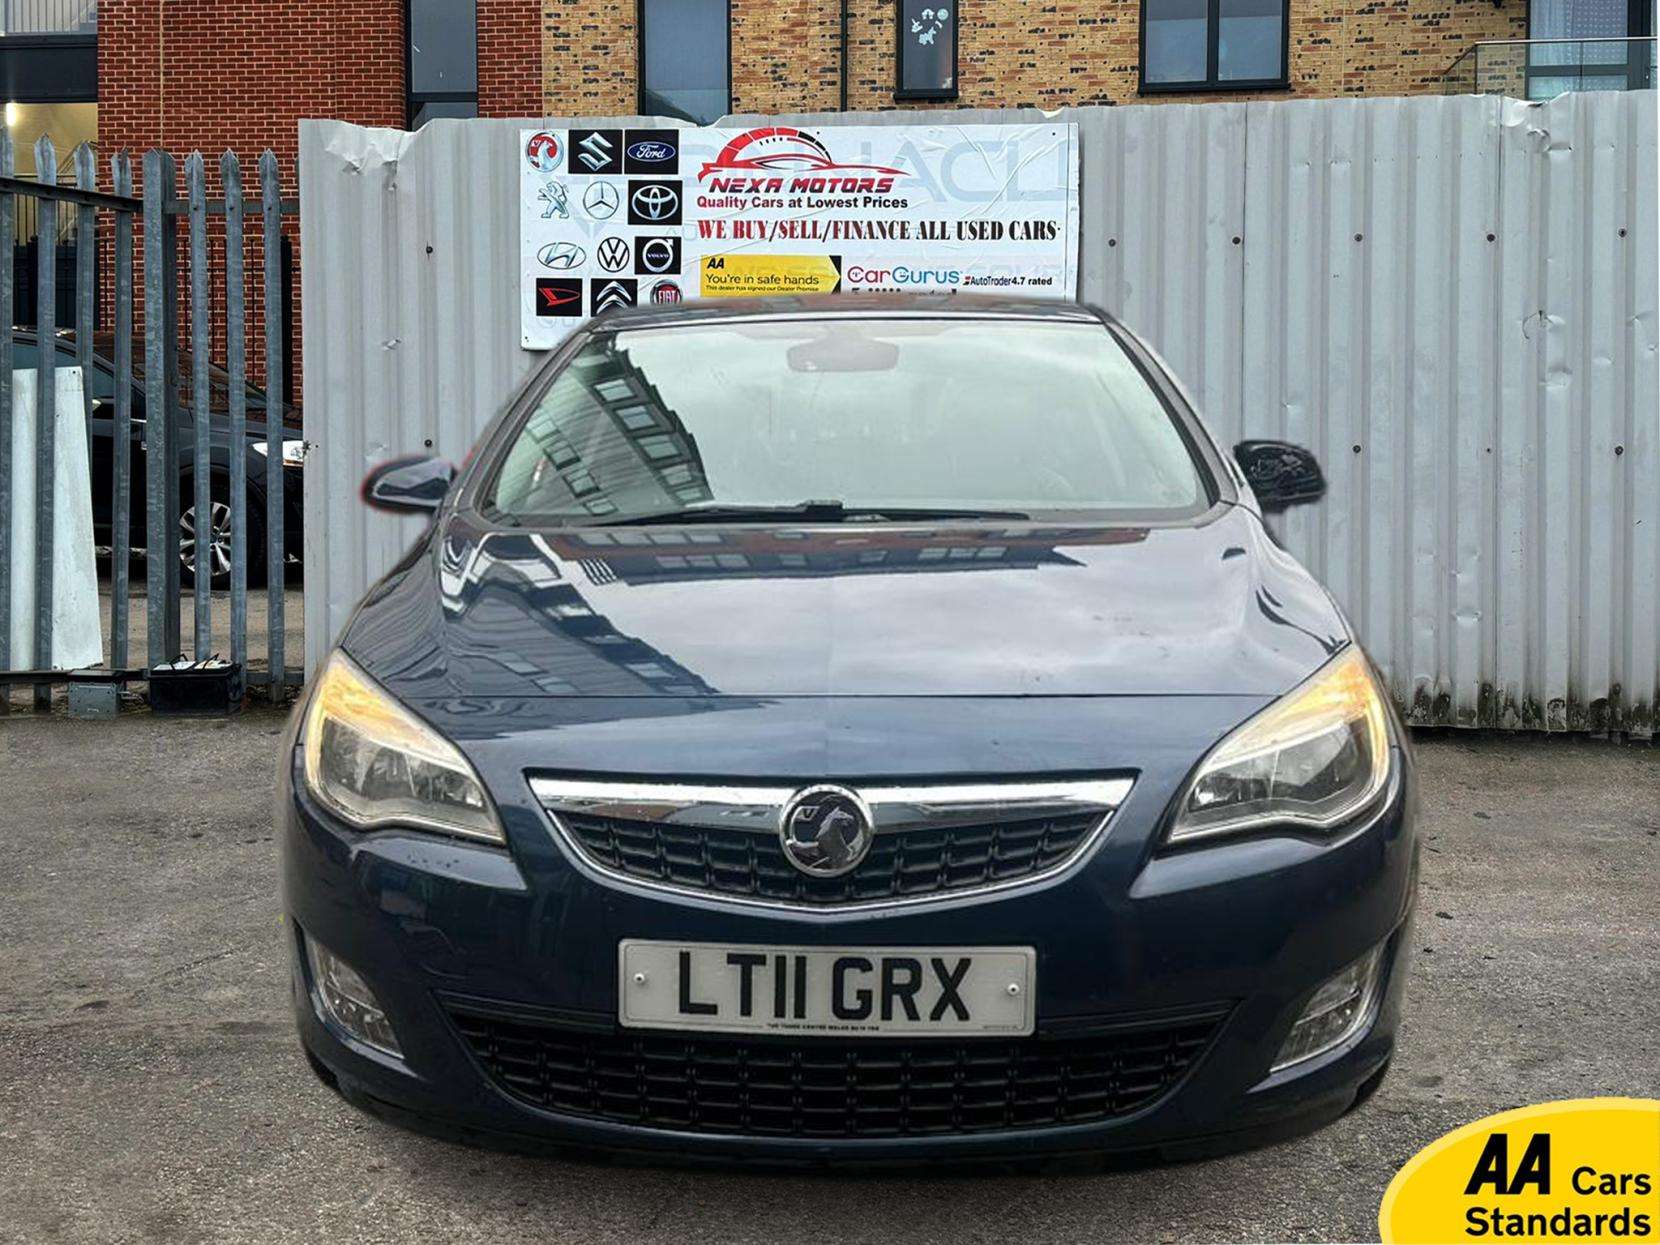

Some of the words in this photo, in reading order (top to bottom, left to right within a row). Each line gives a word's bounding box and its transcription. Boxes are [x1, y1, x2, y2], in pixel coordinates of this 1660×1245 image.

[636, 144, 666, 159] Ford
[709, 178, 783, 193] NEXA
[790, 178, 894, 193] MOTORS
[697, 196, 745, 210] Quality
[752, 196, 784, 208] Cars
[789, 197, 801, 208] at
[807, 196, 858, 208] Lowest
[863, 196, 908, 208] Prices
[698, 219, 727, 239] WE
[916, 220, 950, 240] ALL
[957, 220, 1004, 240] USED
[1009, 220, 1057, 240] CARS
[707, 258, 724, 269] AA
[706, 274, 741, 284] You're
[744, 274, 754, 284] in
[757, 274, 781, 285] safe
[784, 275, 819, 286] hands
[847, 266, 960, 284] CarGurus
[1028, 276, 1052, 286] rated
[679, 951, 807, 1019] LT11
[832, 957, 971, 1021] GRX
